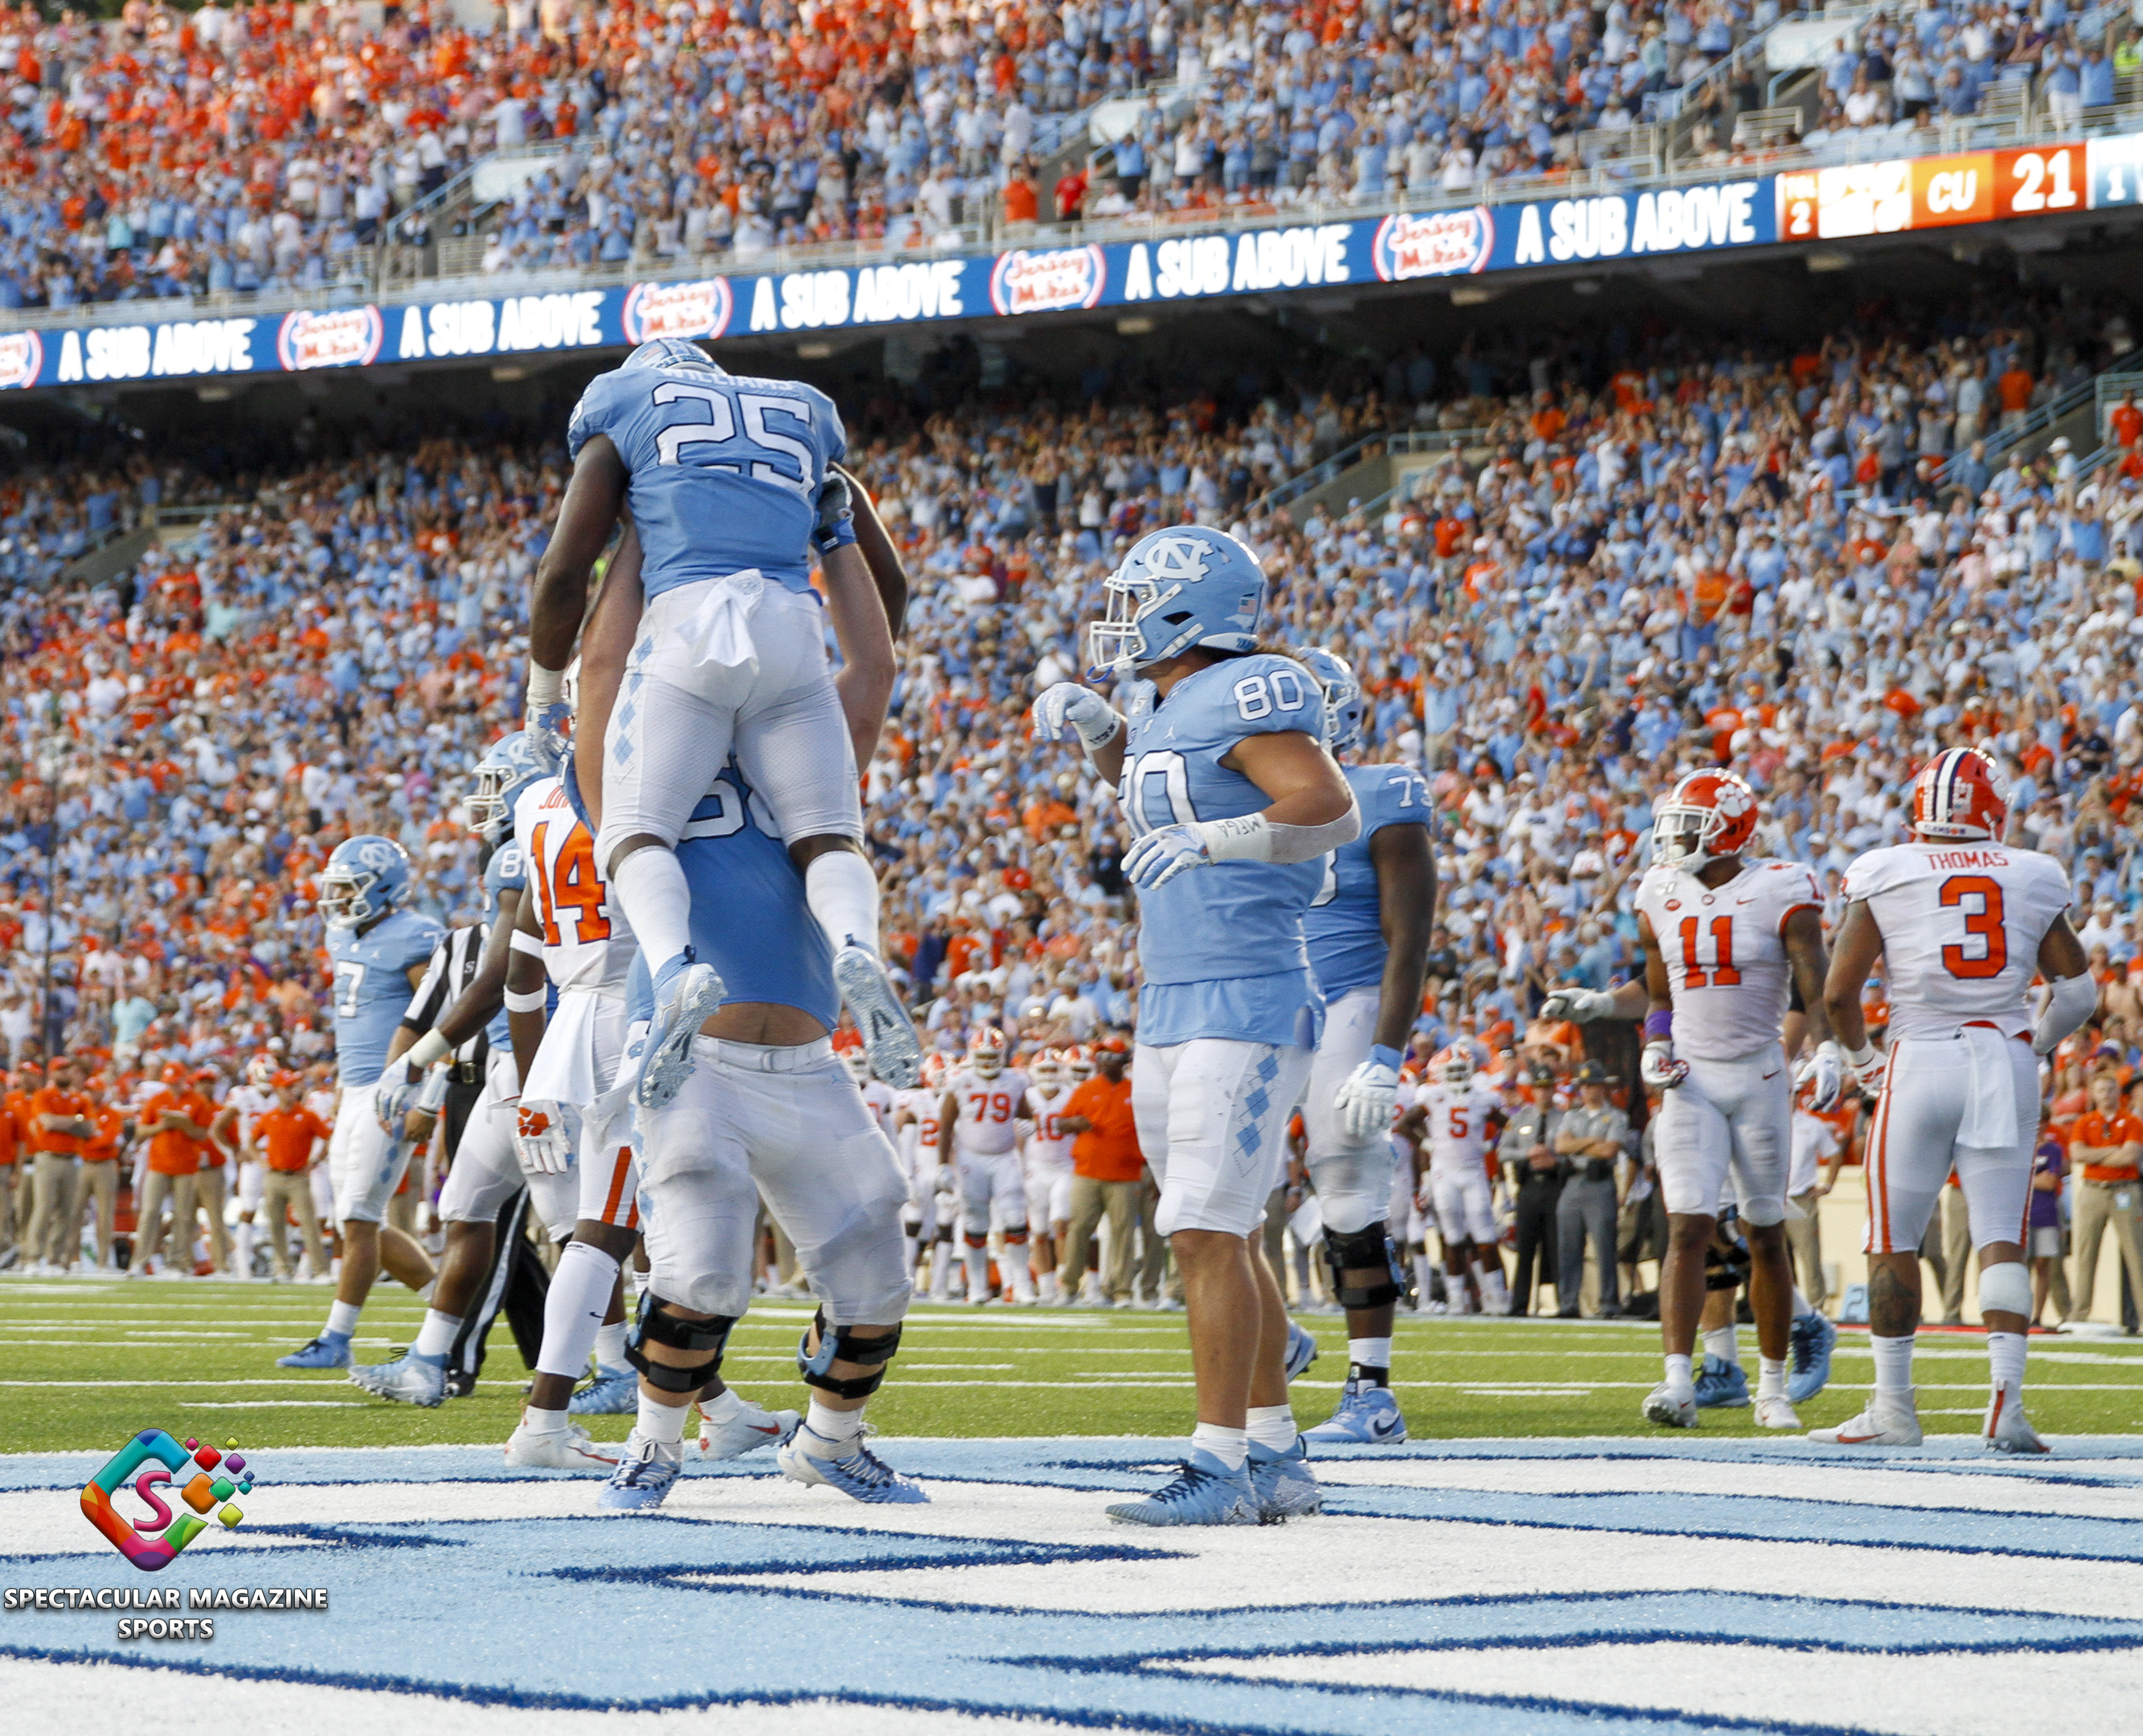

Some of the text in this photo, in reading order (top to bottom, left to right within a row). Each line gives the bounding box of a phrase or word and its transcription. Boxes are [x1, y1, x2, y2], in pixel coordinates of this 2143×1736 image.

[1927, 169, 1978, 214] CU
[2012, 149, 2077, 212] 21
[2107, 165, 2126, 201] 1
[1515, 204, 1545, 264] A
[1549, 195, 1628, 261] SUB
[1631, 182, 1759, 254] ABOVE
[1790, 201, 1811, 235] 2
[1124, 224, 1352, 301] A SUB ABOVE
[399, 291, 606, 359] A SUB ABOVE
[750, 259, 966, 332] A SUB ABOVE
[58, 330, 84, 382] A
[85, 325, 151, 380] SUB
[151, 318, 257, 376] ABOVE
[652, 381, 816, 495] 25
[1232, 669, 1304, 721] 80
[499, 848, 528, 878] 8
[531, 819, 611, 947] 14
[1924, 850, 2010, 870] THOMAS
[1679, 915, 1741, 989] 11
[1940, 875, 2007, 980] 3
[337, 960, 365, 1017] 7
[969, 1093, 1011, 1123] 79
[1449, 1106, 1468, 1138] 5
